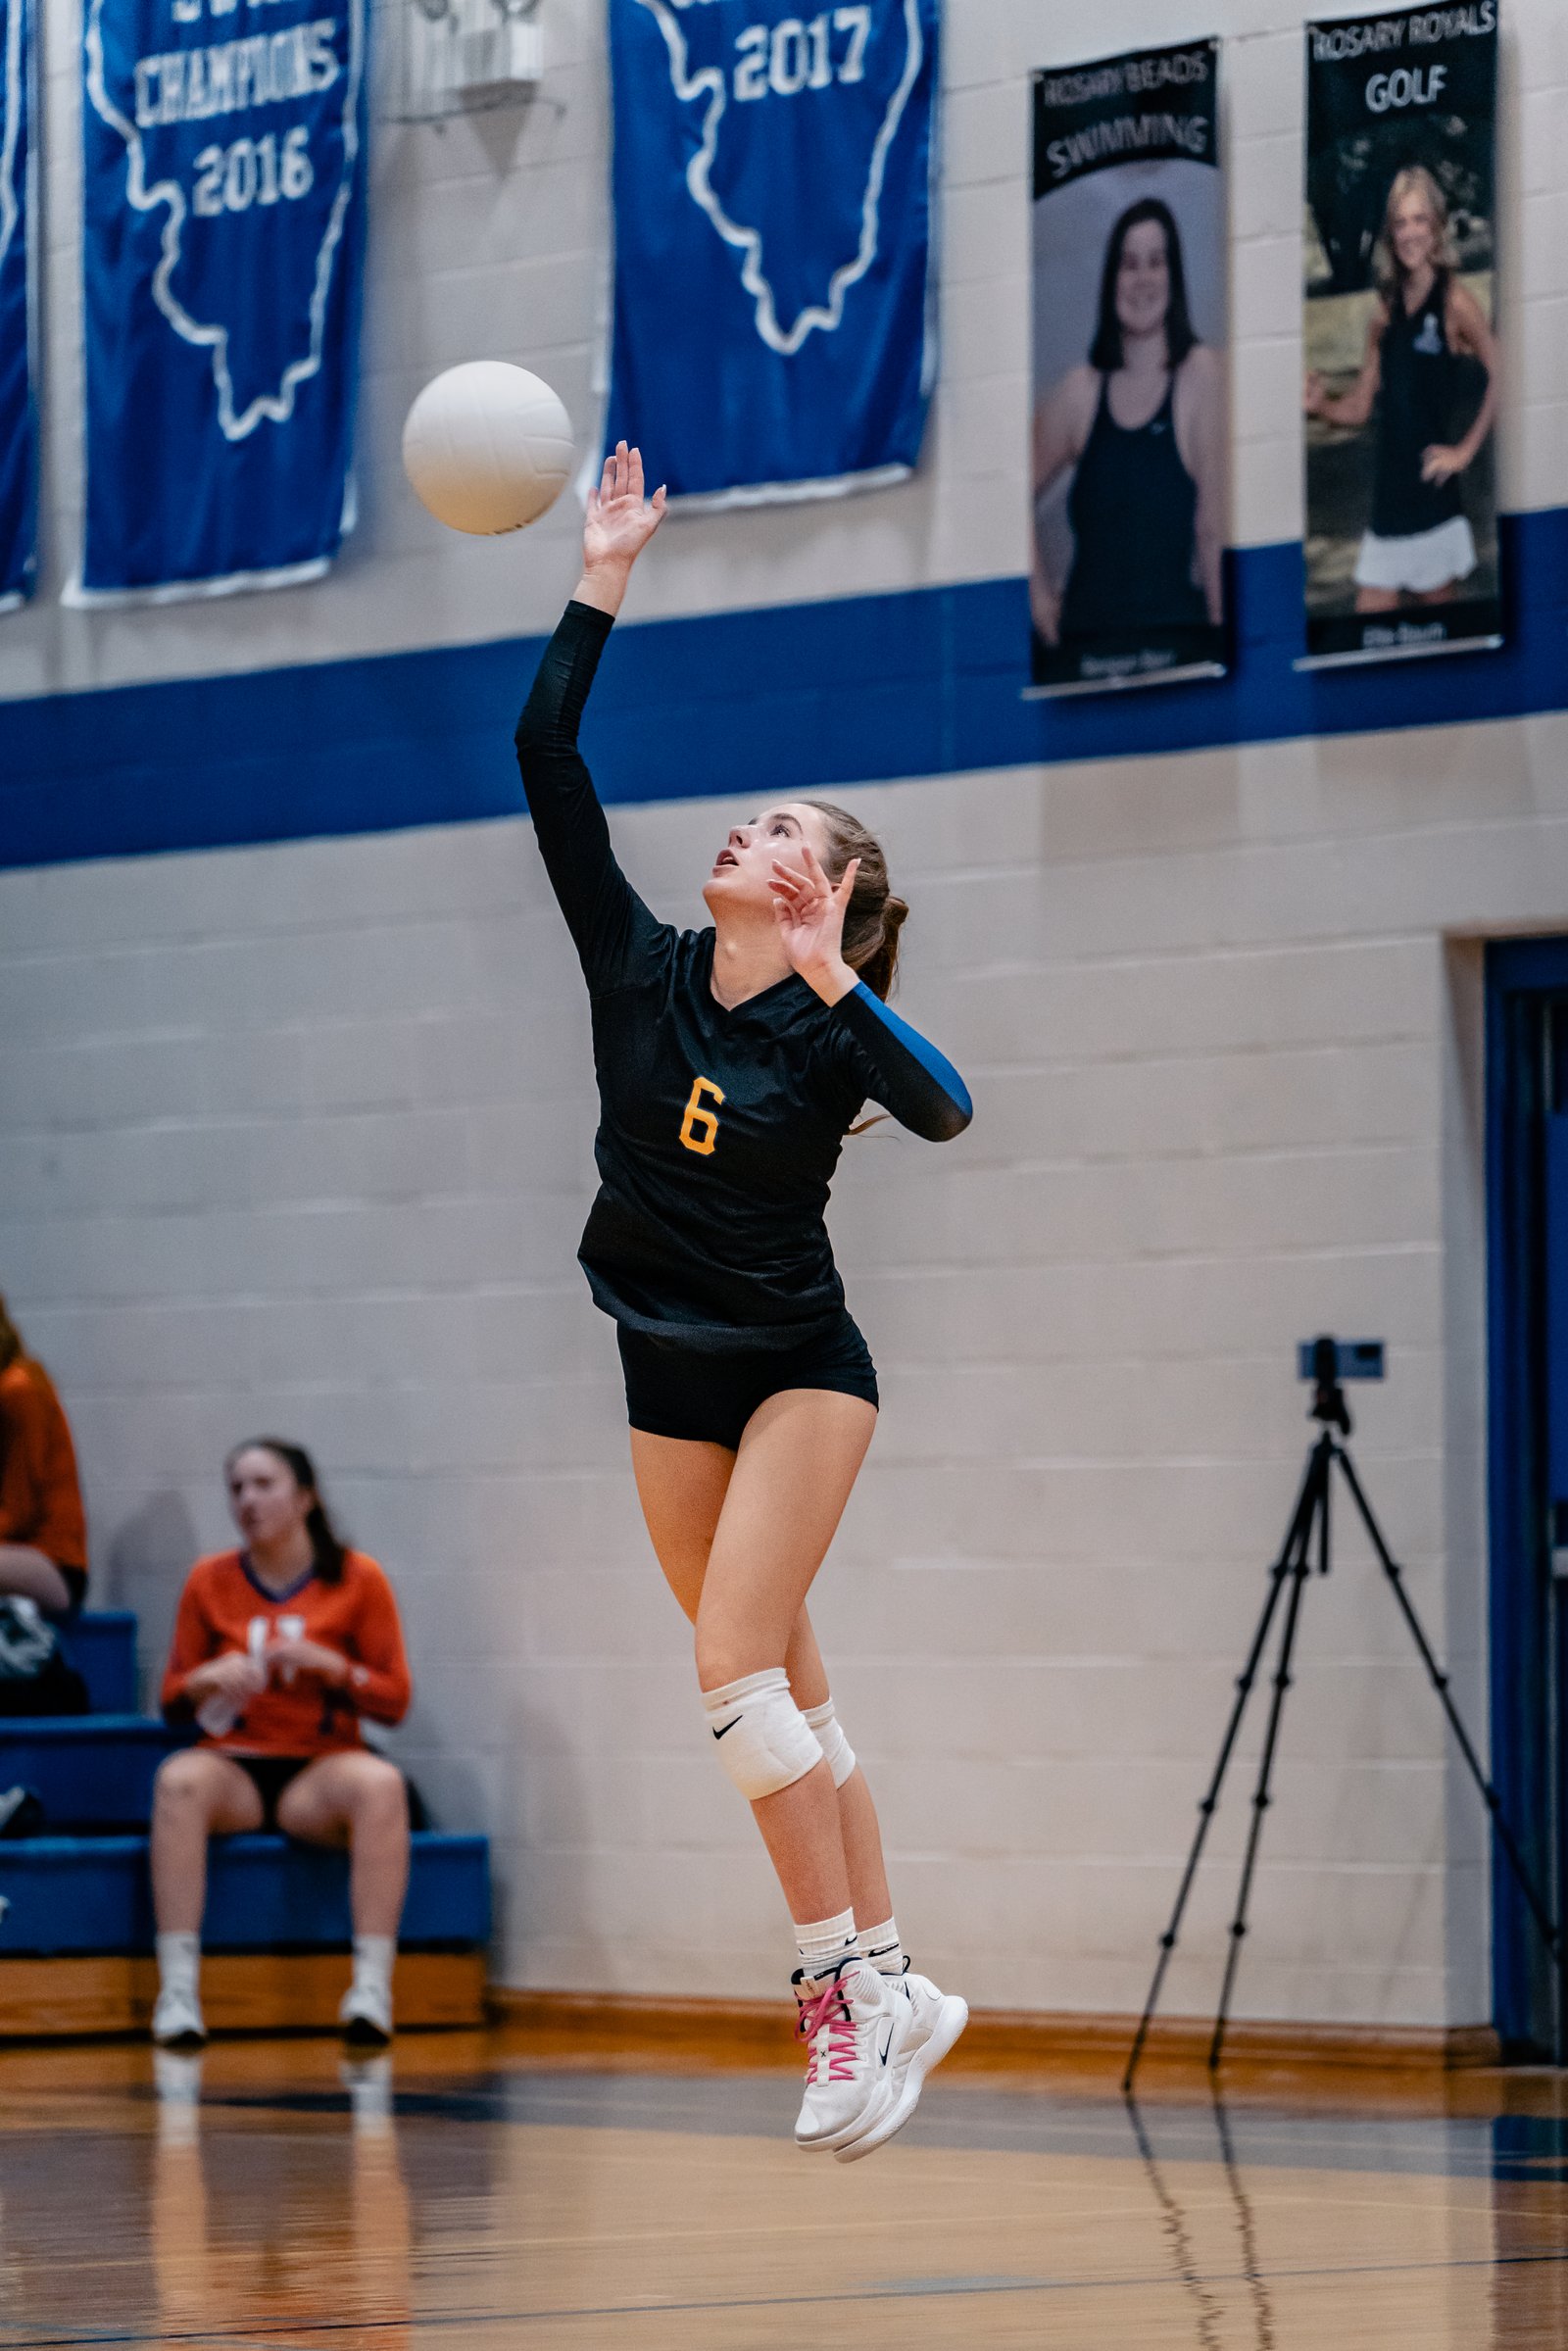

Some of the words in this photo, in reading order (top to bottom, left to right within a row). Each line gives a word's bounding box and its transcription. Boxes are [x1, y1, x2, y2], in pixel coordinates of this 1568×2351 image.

[733, 4, 871, 101] 2017
[1312, 20, 1406, 62] ROSARY
[1408, 0, 1496, 45] ROYALS
[134, 18, 341, 128] CHAMPIONS
[1126, 49, 1209, 93] BEADS
[1364, 64, 1448, 114] GOLF
[192, 125, 315, 217] 2016
[1046, 112, 1208, 179] SWIMMING
[679, 1076, 725, 1155] 6
